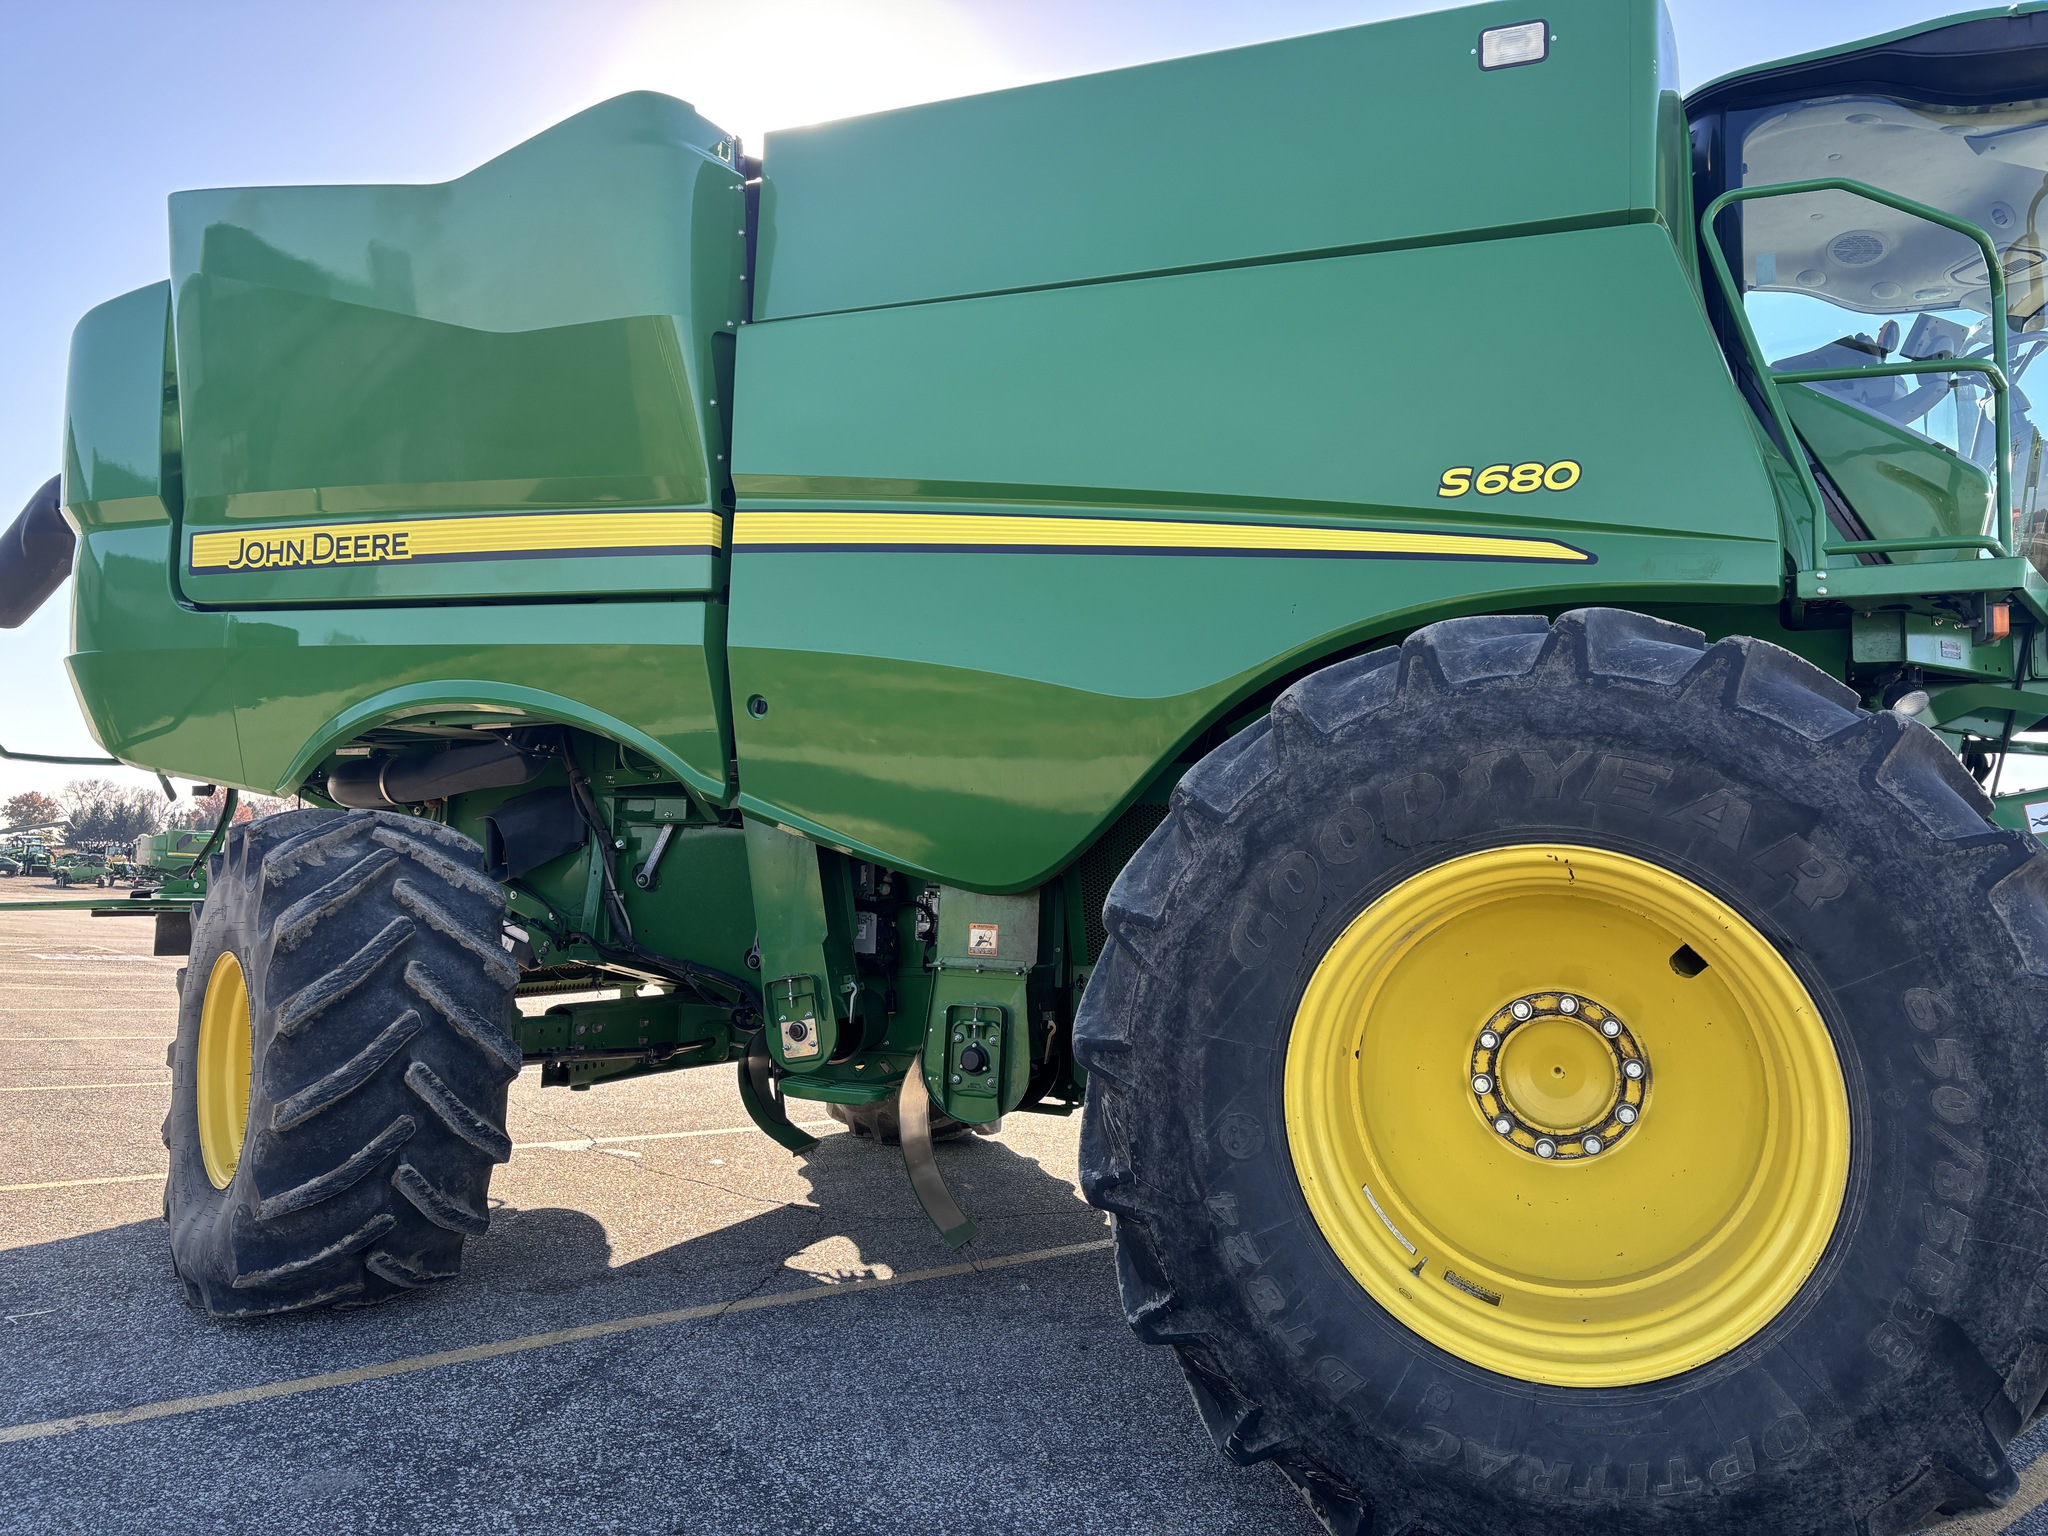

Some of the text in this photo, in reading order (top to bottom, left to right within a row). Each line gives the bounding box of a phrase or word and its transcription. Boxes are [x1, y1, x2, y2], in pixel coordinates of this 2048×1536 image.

[1437, 459, 1582, 498] S680
[229, 532, 409, 566] JOHN DEERE
[1230, 750, 1848, 968] GOODYEAR
[1870, 986, 1984, 1367] 650/85R38
[1416, 1412, 1812, 1499] OPTITRAC
